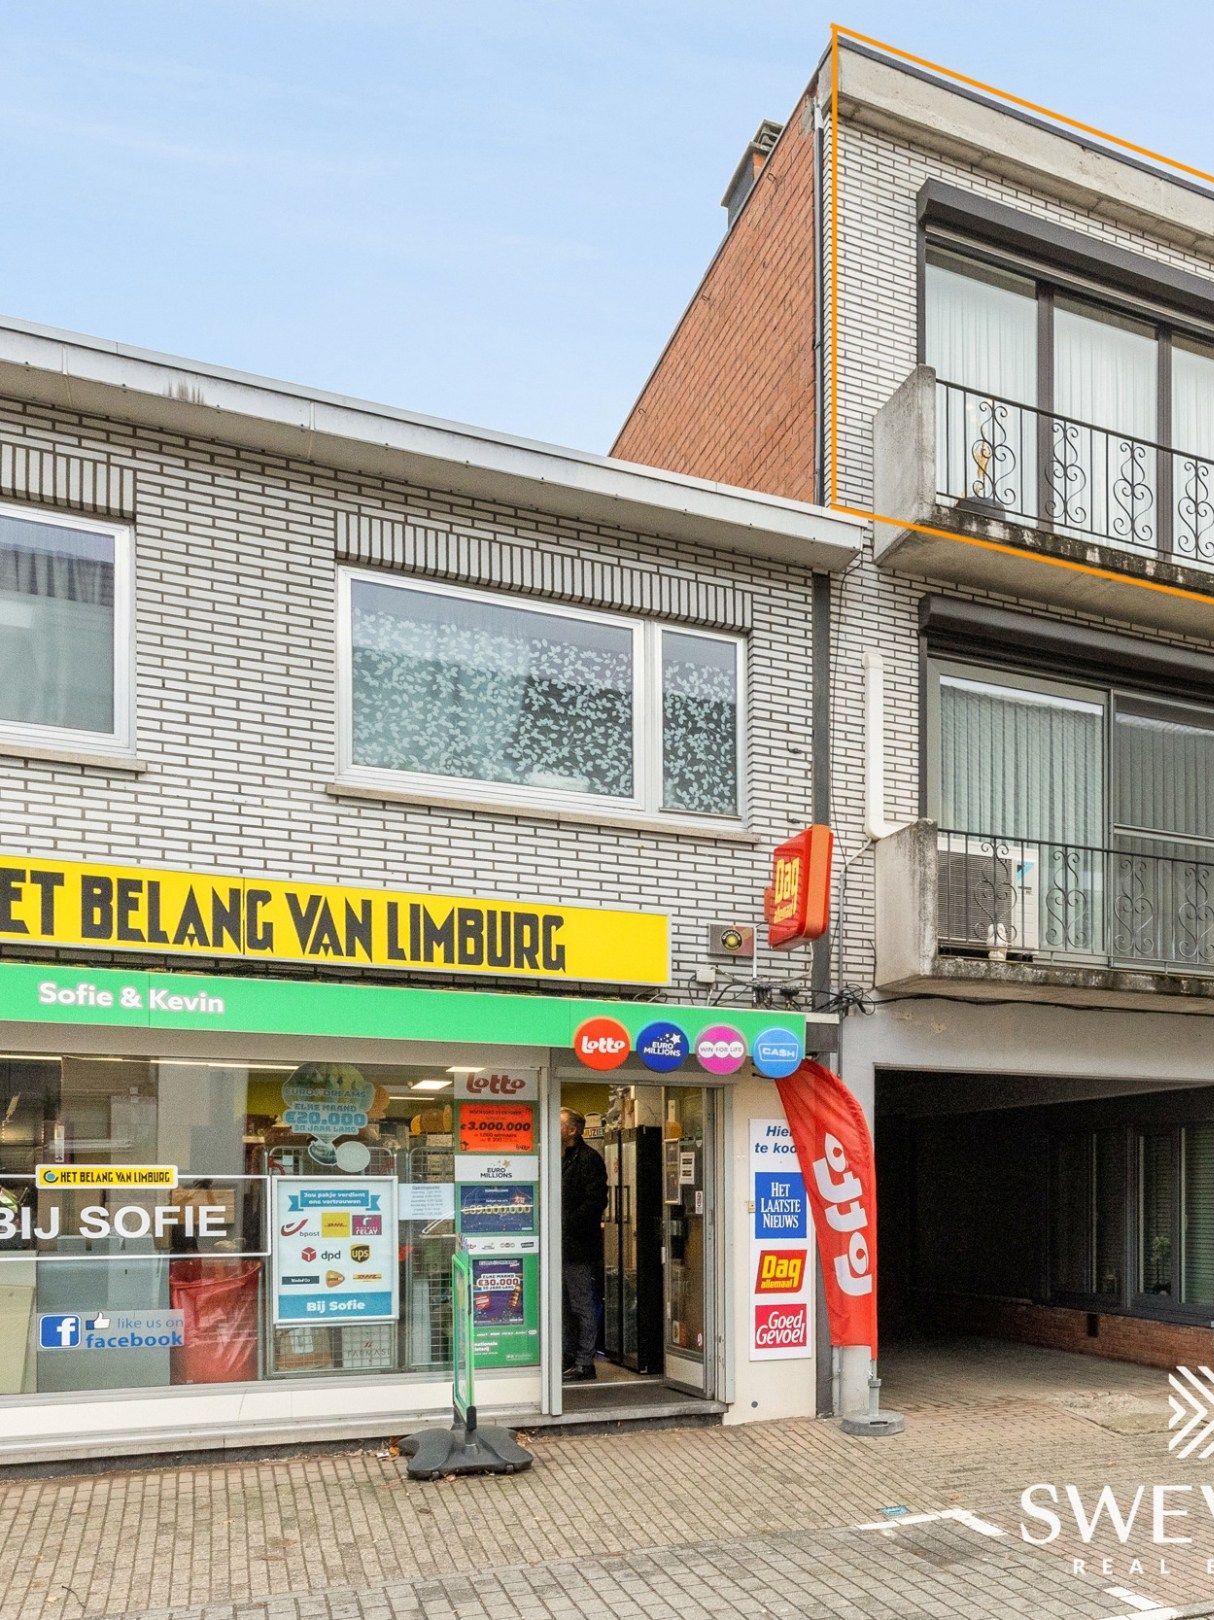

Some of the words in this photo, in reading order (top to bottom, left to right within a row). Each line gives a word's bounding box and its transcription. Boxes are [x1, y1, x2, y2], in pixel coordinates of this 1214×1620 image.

[81, 874, 274, 954] BELANG
[285, 892, 373, 963] VAN
[387, 901, 567, 973] LIMBURG
[38, 980, 114, 1008] Sofie
[119, 986, 143, 1009] &
[149, 988, 225, 1014] Kevin
[643, 1047, 681, 1057] MILLIONS
[652, 1041, 674, 1051] EURO
[762, 1047, 795, 1058] CASH
[754, 1143, 769, 1154] te
[772, 1142, 798, 1154] koo
[60, 1171, 78, 1183] HET
[79, 1171, 114, 1183] BELANG
[115, 1171, 132, 1183] VAN
[134, 1171, 170, 1183] LIMBURG
[771, 1182, 791, 1197] HET
[760, 1197, 801, 1213] LAATSTE
[0, 1206, 60, 1240] BIJ
[79, 1205, 228, 1239] SOFIE
[763, 1213, 799, 1228] NIEUWS
[321, 1250, 341, 1261] dpd
[351, 1250, 369, 1260] ups
[761, 1255, 802, 1288] Dag
[761, 1279, 793, 1289] allemaal
[306, 1300, 326, 1314] Bij
[329, 1298, 366, 1311] Sofie
[117, 1317, 142, 1329] like
[146, 1318, 162, 1328] us
[165, 1318, 184, 1328] on
[768, 1309, 804, 1328] Goed
[85, 1331, 182, 1348] facebook
[756, 1322, 806, 1345] Gevoel
